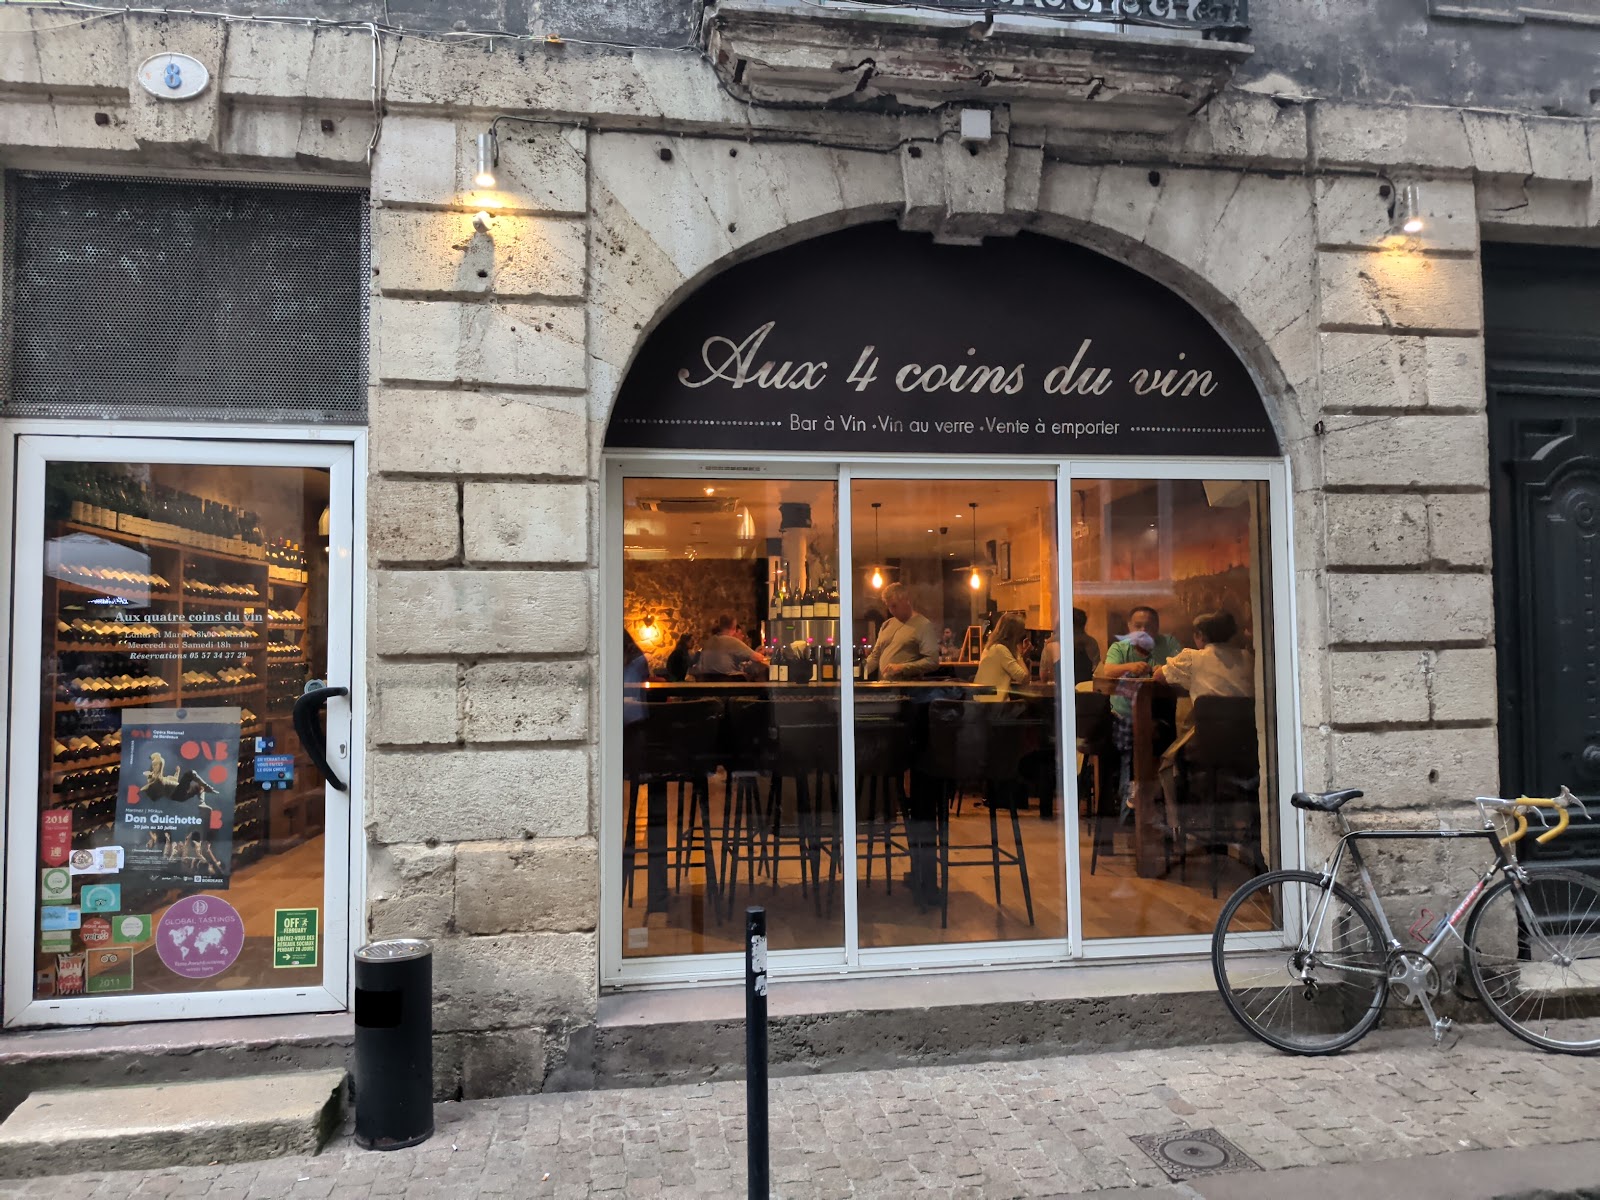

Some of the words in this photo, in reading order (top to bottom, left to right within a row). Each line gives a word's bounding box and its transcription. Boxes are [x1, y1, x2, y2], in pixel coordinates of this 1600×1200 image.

[164, 63, 182, 89] 8
[678, 320, 828, 390] Aux
[846, 345, 879, 392] 4
[895, 347, 1025, 395] coins
[1044, 338, 1113, 395] du
[1129, 352, 1219, 397] vin
[790, 413, 817, 431] Bar
[823, 415, 835, 431] à
[840, 414, 866, 431] Vin
[909, 420, 929, 433] au
[935, 421, 974, 434] verre
[1035, 418, 1046, 434] à
[1051, 420, 1120, 439] emporter
[114, 612, 141, 622] Aux
[143, 613, 186, 624] quatre
[188, 611, 221, 622] coins
[224, 611, 240, 622] du
[244, 612, 263, 622] vin
[127, 641, 166, 649] Mercredi
[181, 641, 214, 649] Samedi
[216, 641, 231, 649] 18h
[129, 651, 187, 660] Réservations
[189, 651, 199, 659] 05
[201, 651, 211, 659] 57
[213, 651, 223, 659] 34
[225, 651, 235, 659] 37
[237, 651, 247, 659] 29
[45, 814, 69, 824] 2016
[125, 813, 147, 823] Don
[150, 814, 203, 825] Quichotte
[164, 918, 196, 926] GLOBAL
[198, 915, 236, 924] TASTINGS
[283, 918, 300, 928] OFF
[60, 961, 80, 970] 2011
[99, 978, 120, 988] 2011
